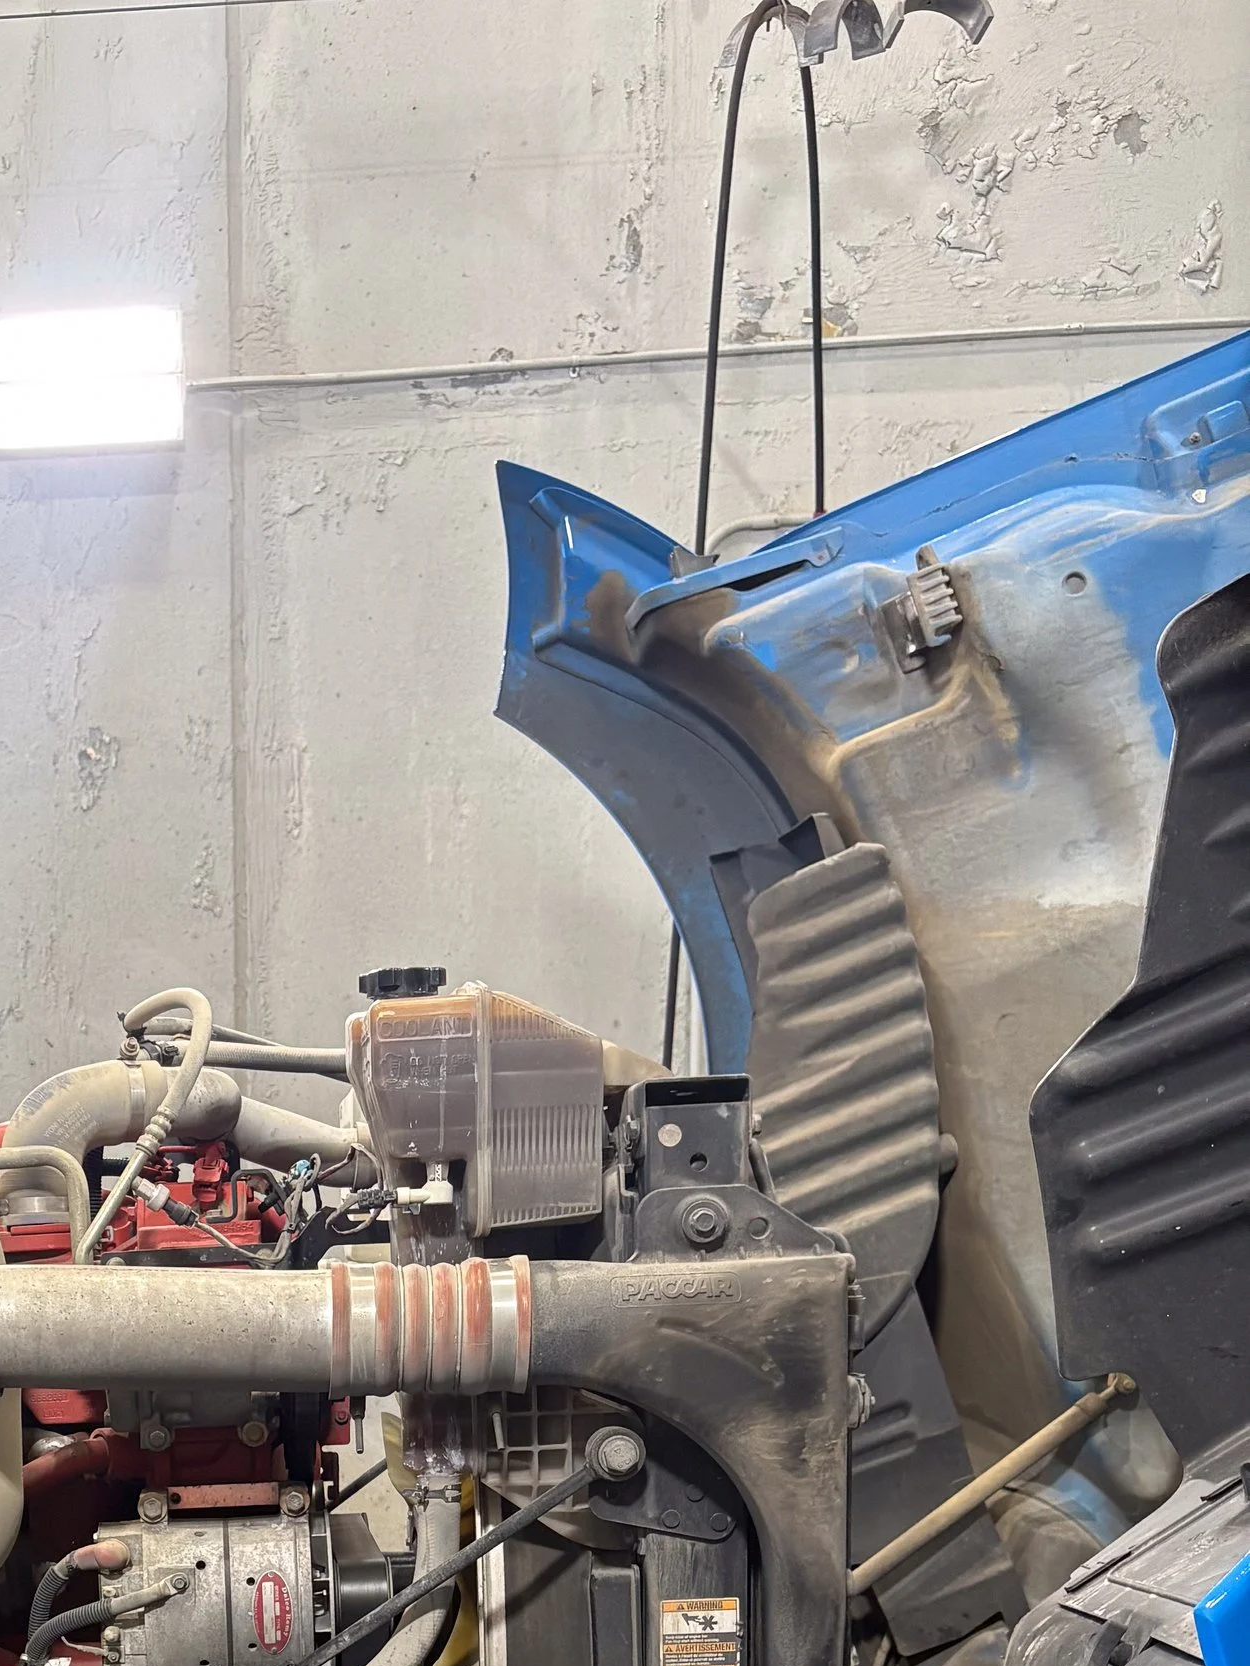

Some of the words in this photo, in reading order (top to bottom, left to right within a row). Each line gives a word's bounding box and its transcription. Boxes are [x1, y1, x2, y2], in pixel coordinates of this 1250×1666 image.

[380, 1016, 471, 1038] COOLANT
[620, 1277, 734, 1301] PACCAR
[686, 1600, 724, 1610] WARNING
[675, 1643, 735, 1652] AVERTISSEMENT
